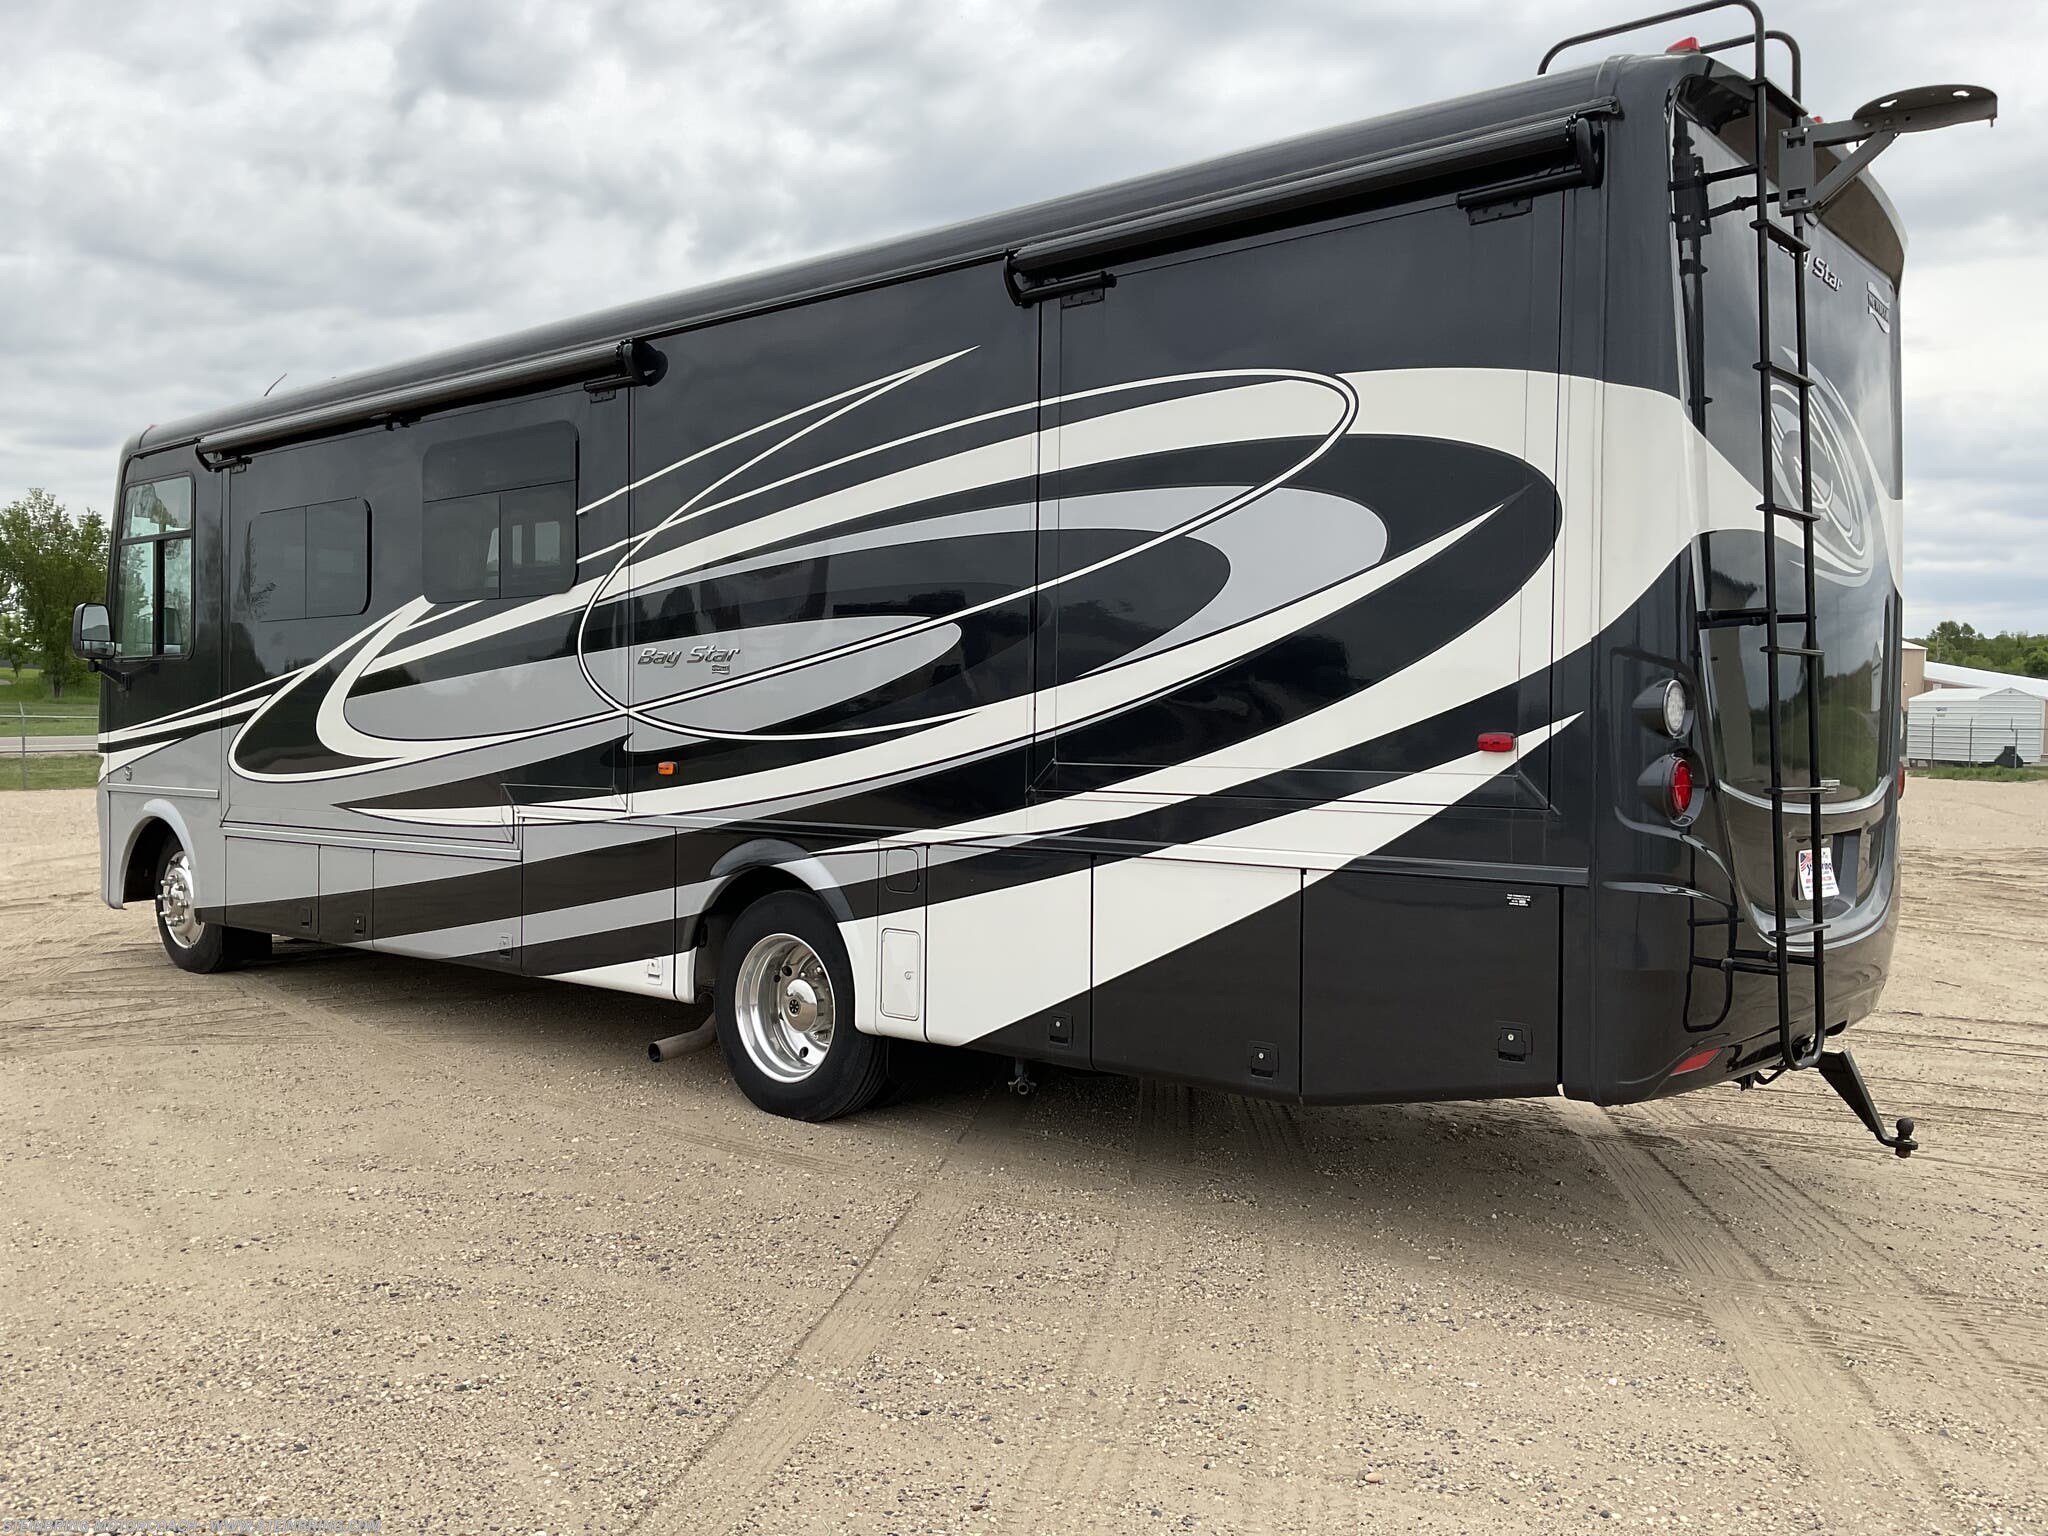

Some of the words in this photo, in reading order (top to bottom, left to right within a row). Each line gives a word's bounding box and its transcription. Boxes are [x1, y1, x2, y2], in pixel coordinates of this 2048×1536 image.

[1812, 256, 1843, 292] Star
[637, 647, 682, 669] Bay
[686, 644, 741, 664] Star
